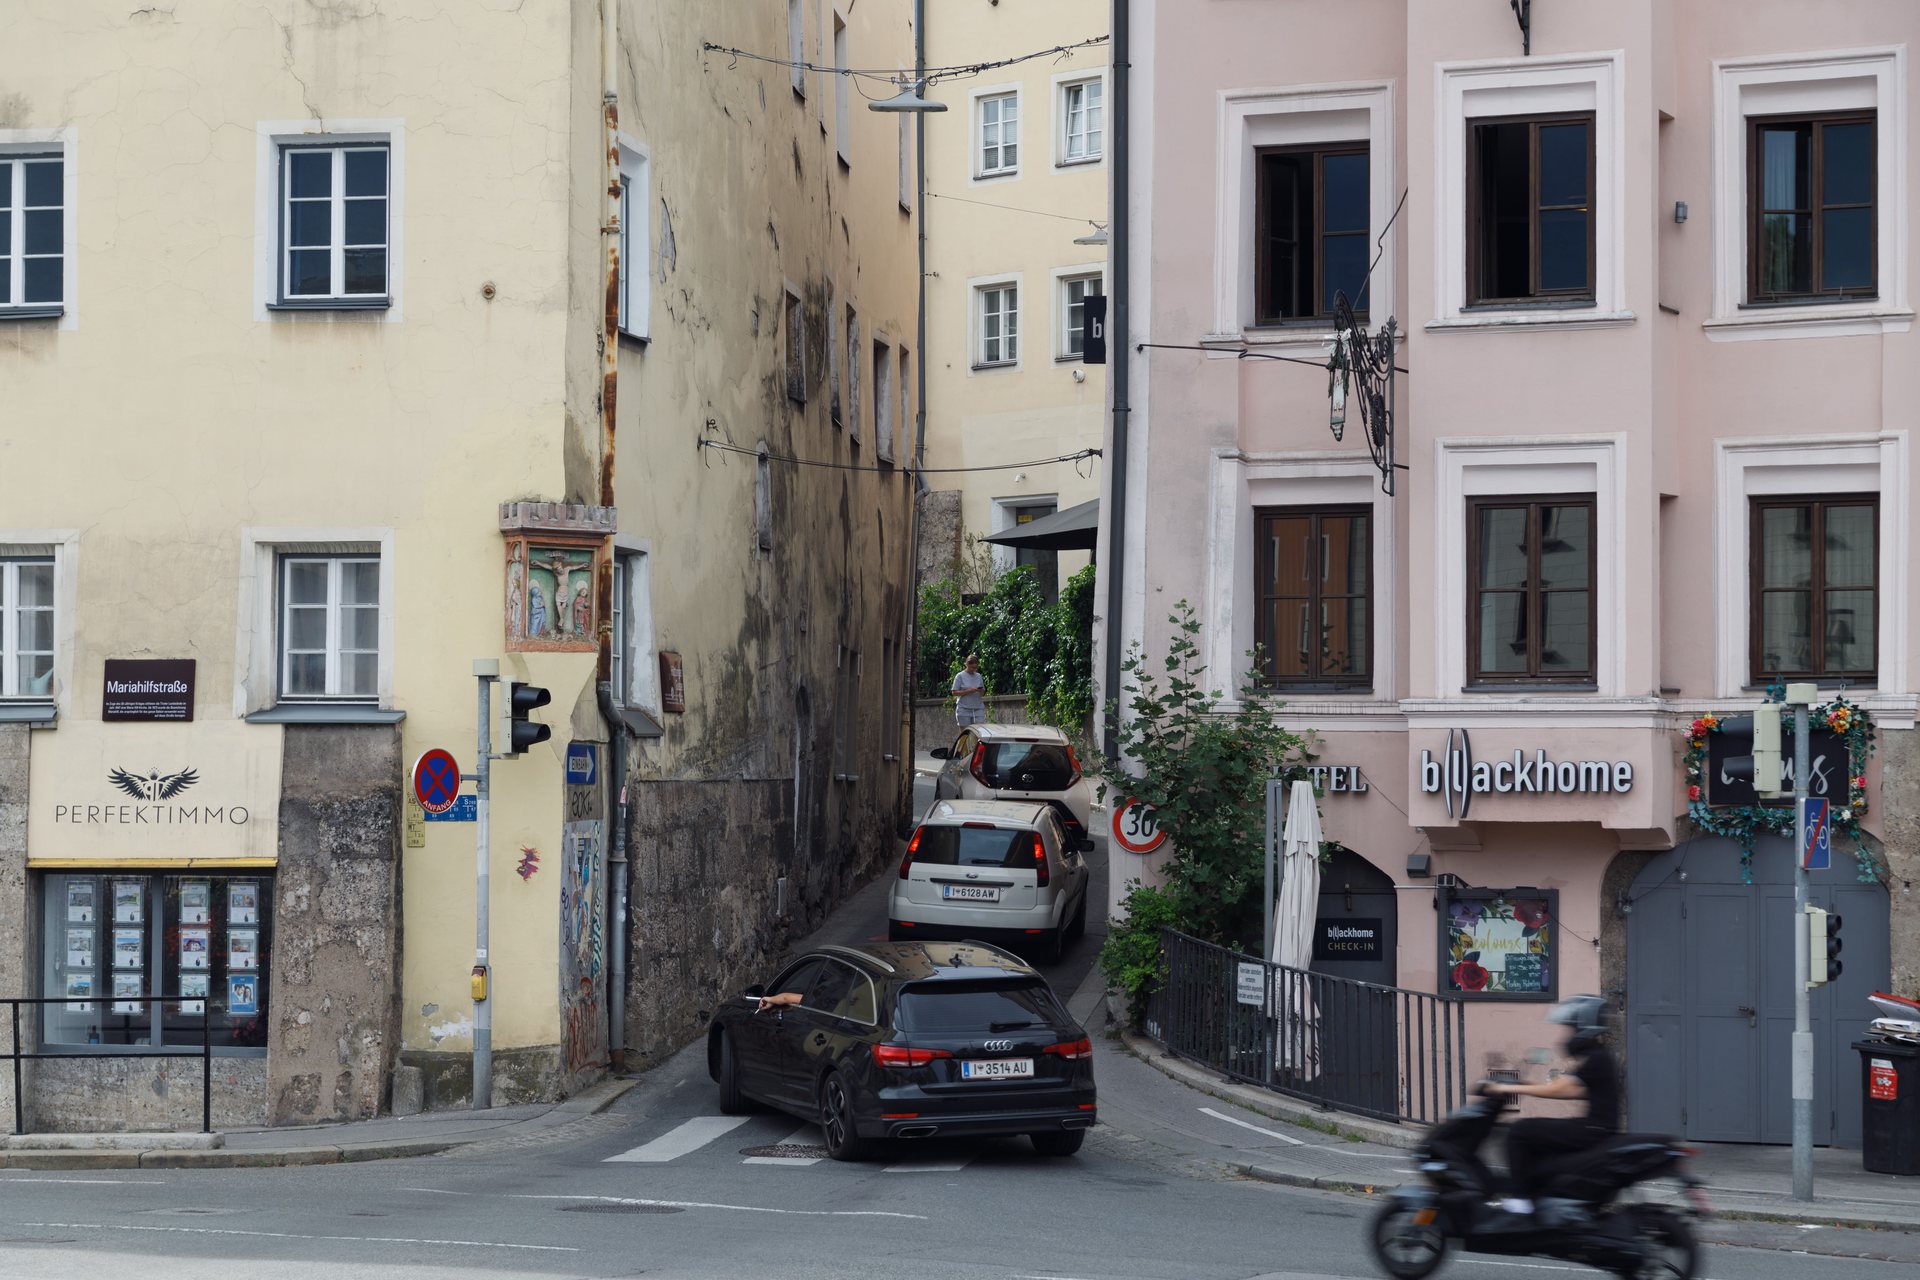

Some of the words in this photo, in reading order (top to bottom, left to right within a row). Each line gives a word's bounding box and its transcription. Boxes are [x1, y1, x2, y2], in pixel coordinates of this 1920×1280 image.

[106, 680, 188, 693] Mariahilfstraße
[422, 799, 452, 812] ANFANG
[55, 804, 249, 825] PERFEKTIMMO
[1126, 804, 1156, 838] 30
[961, 888, 981, 898] 6128
[982, 889, 995, 898] AW
[1327, 942, 1375, 951] CHECK-IN
[985, 1062, 1011, 1075] 3514
[1013, 1061, 1027, 1074] AU
